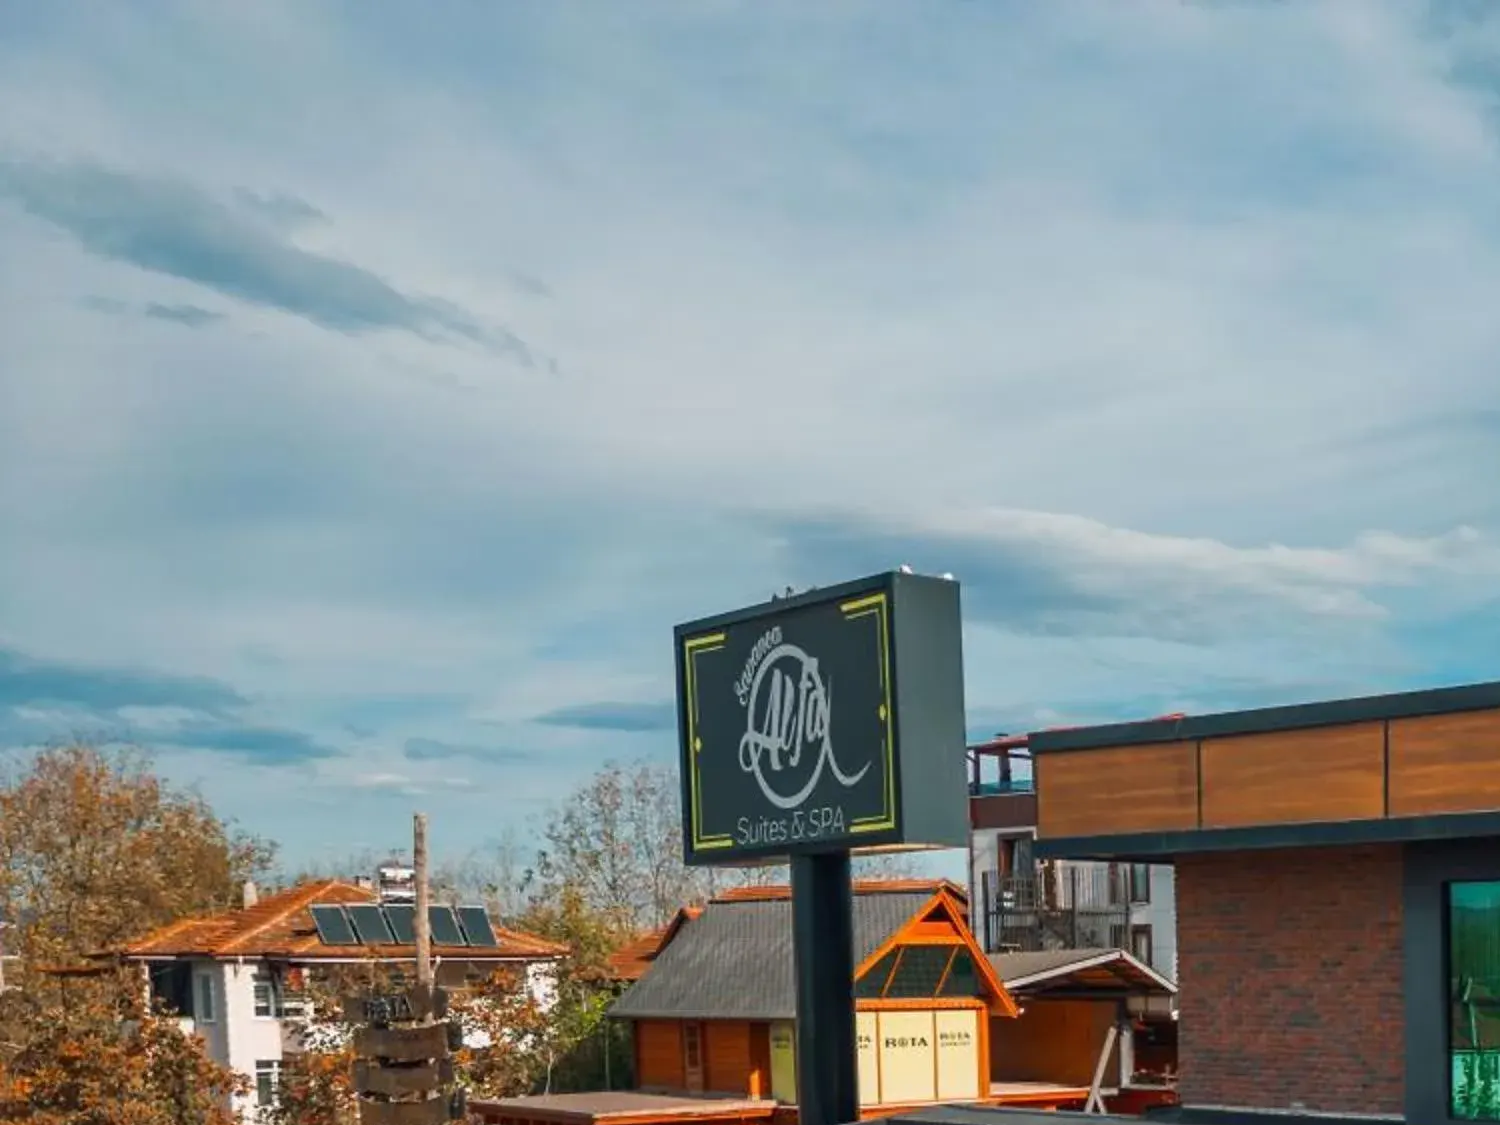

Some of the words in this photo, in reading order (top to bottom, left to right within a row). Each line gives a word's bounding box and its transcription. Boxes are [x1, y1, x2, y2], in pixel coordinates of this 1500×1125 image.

[737, 815, 787, 845] Suites
[791, 811, 806, 840] &
[808, 806, 846, 839] SPA
